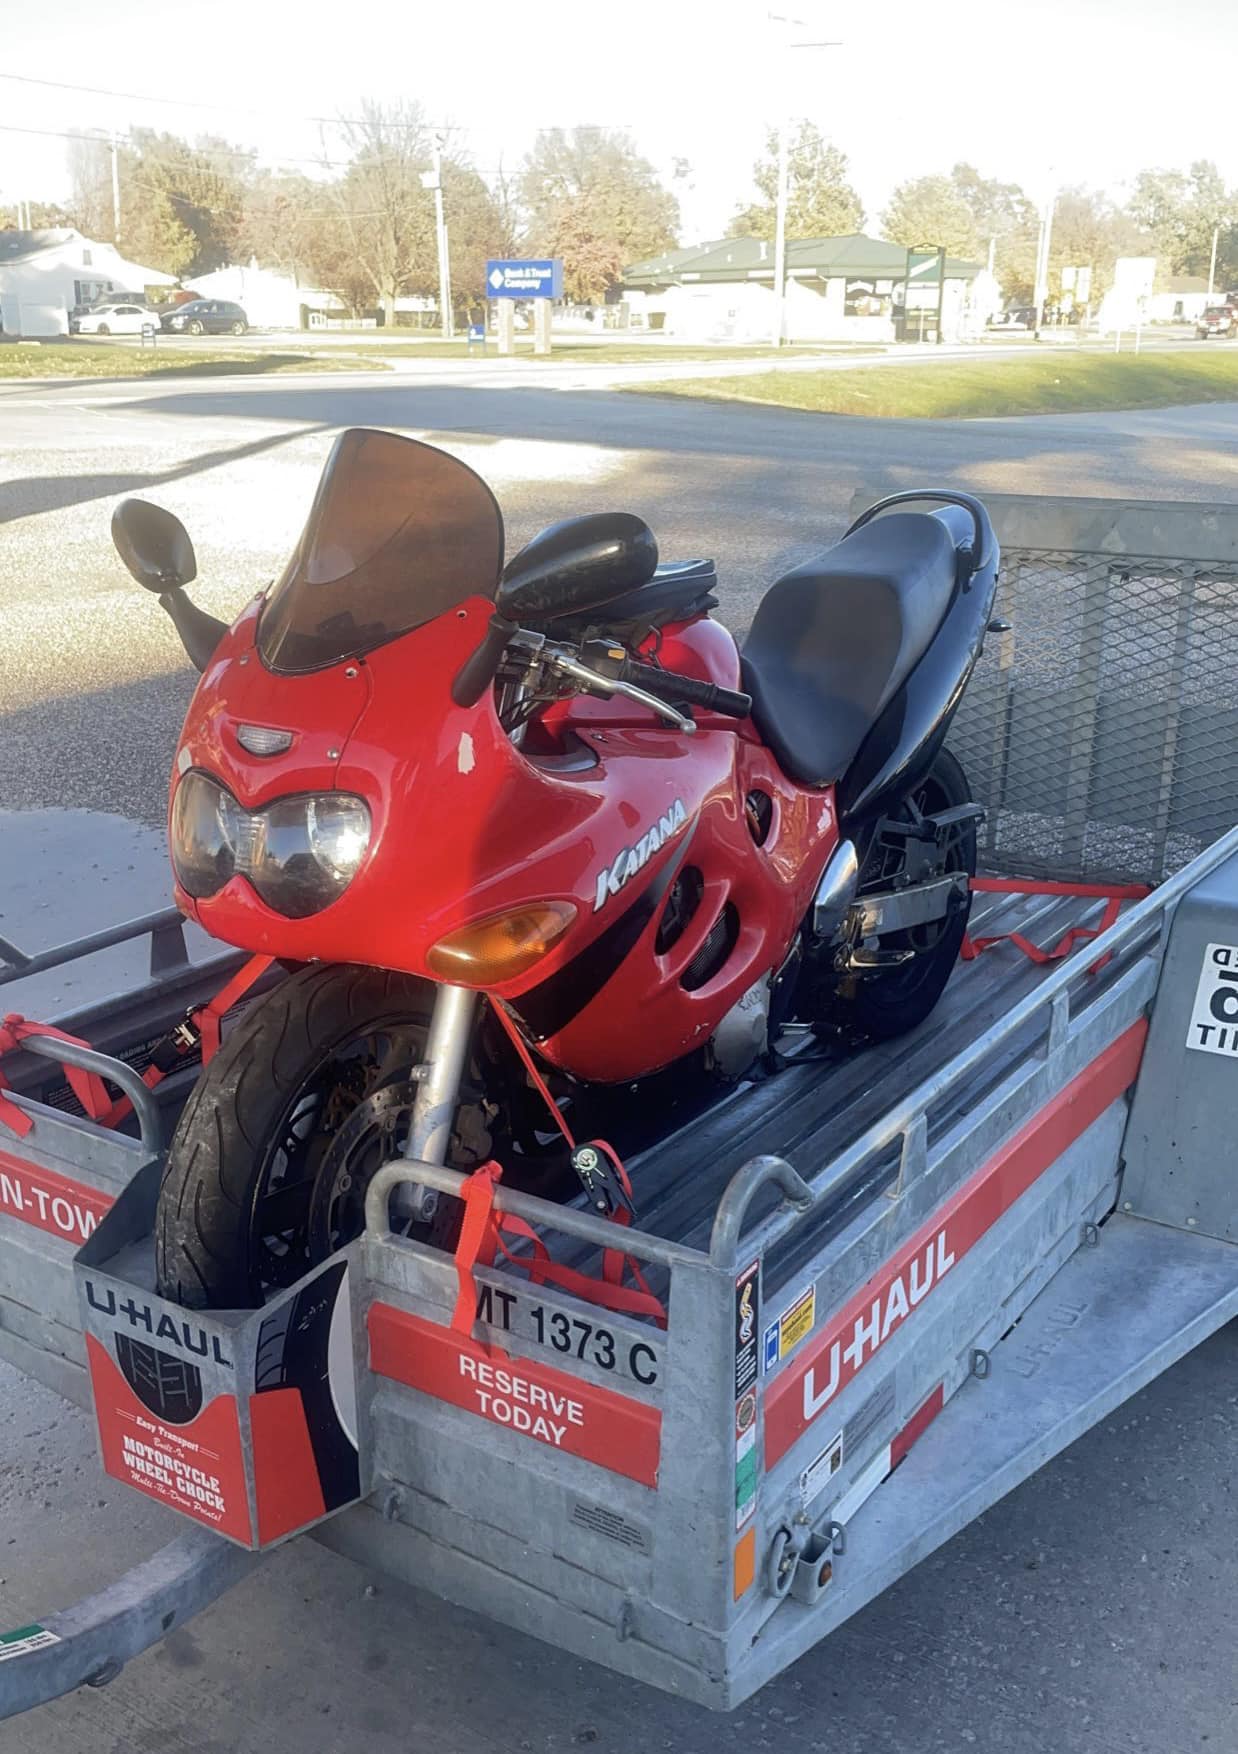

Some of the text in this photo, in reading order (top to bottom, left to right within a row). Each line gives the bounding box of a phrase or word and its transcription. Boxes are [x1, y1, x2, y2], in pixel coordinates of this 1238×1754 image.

[593, 799, 688, 912] KATANA
[86, 1281, 234, 1367] U-HAUL
[530, 1306, 616, 1370] 1373
[629, 1343, 658, 1385] C
[803, 1230, 956, 1421] U-HAUL
[459, 1354, 585, 1426] RESERVE
[475, 1390, 567, 1445] TODAY
[123, 1435, 221, 1493] MOTORCYCLE
[136, 1416, 199, 1452] Easy Transport
[122, 1450, 226, 1512] WHEEL CHOCK
